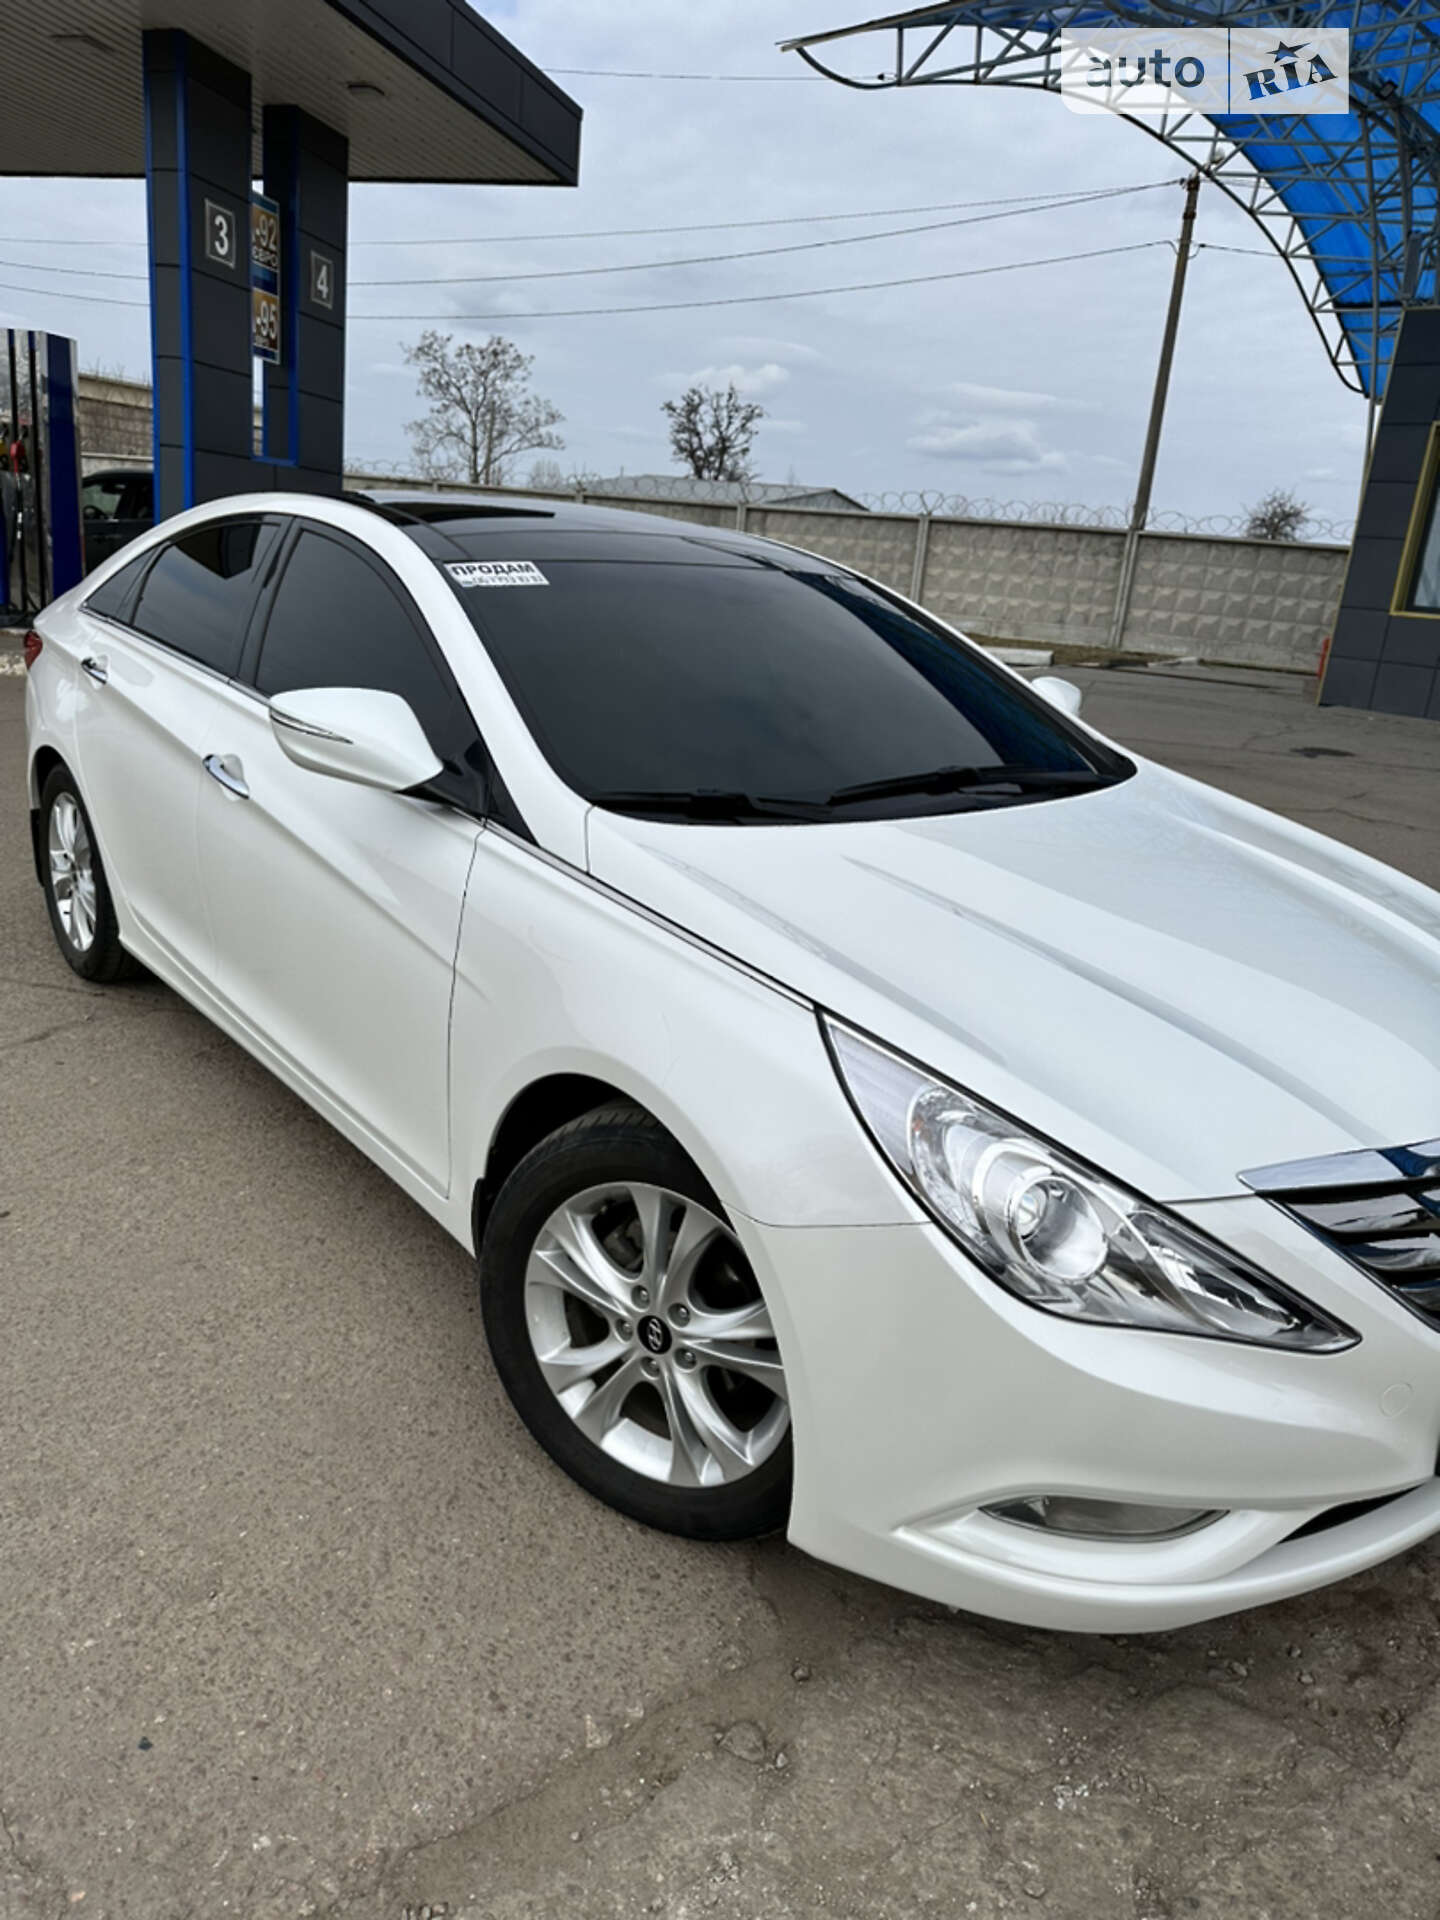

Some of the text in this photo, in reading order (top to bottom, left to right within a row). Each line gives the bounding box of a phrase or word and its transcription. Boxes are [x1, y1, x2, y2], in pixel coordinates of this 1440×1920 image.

[214, 214, 229, 256] 3
[316, 264, 329, 299] 4
[451, 564, 536, 576] ПРОДАМ
